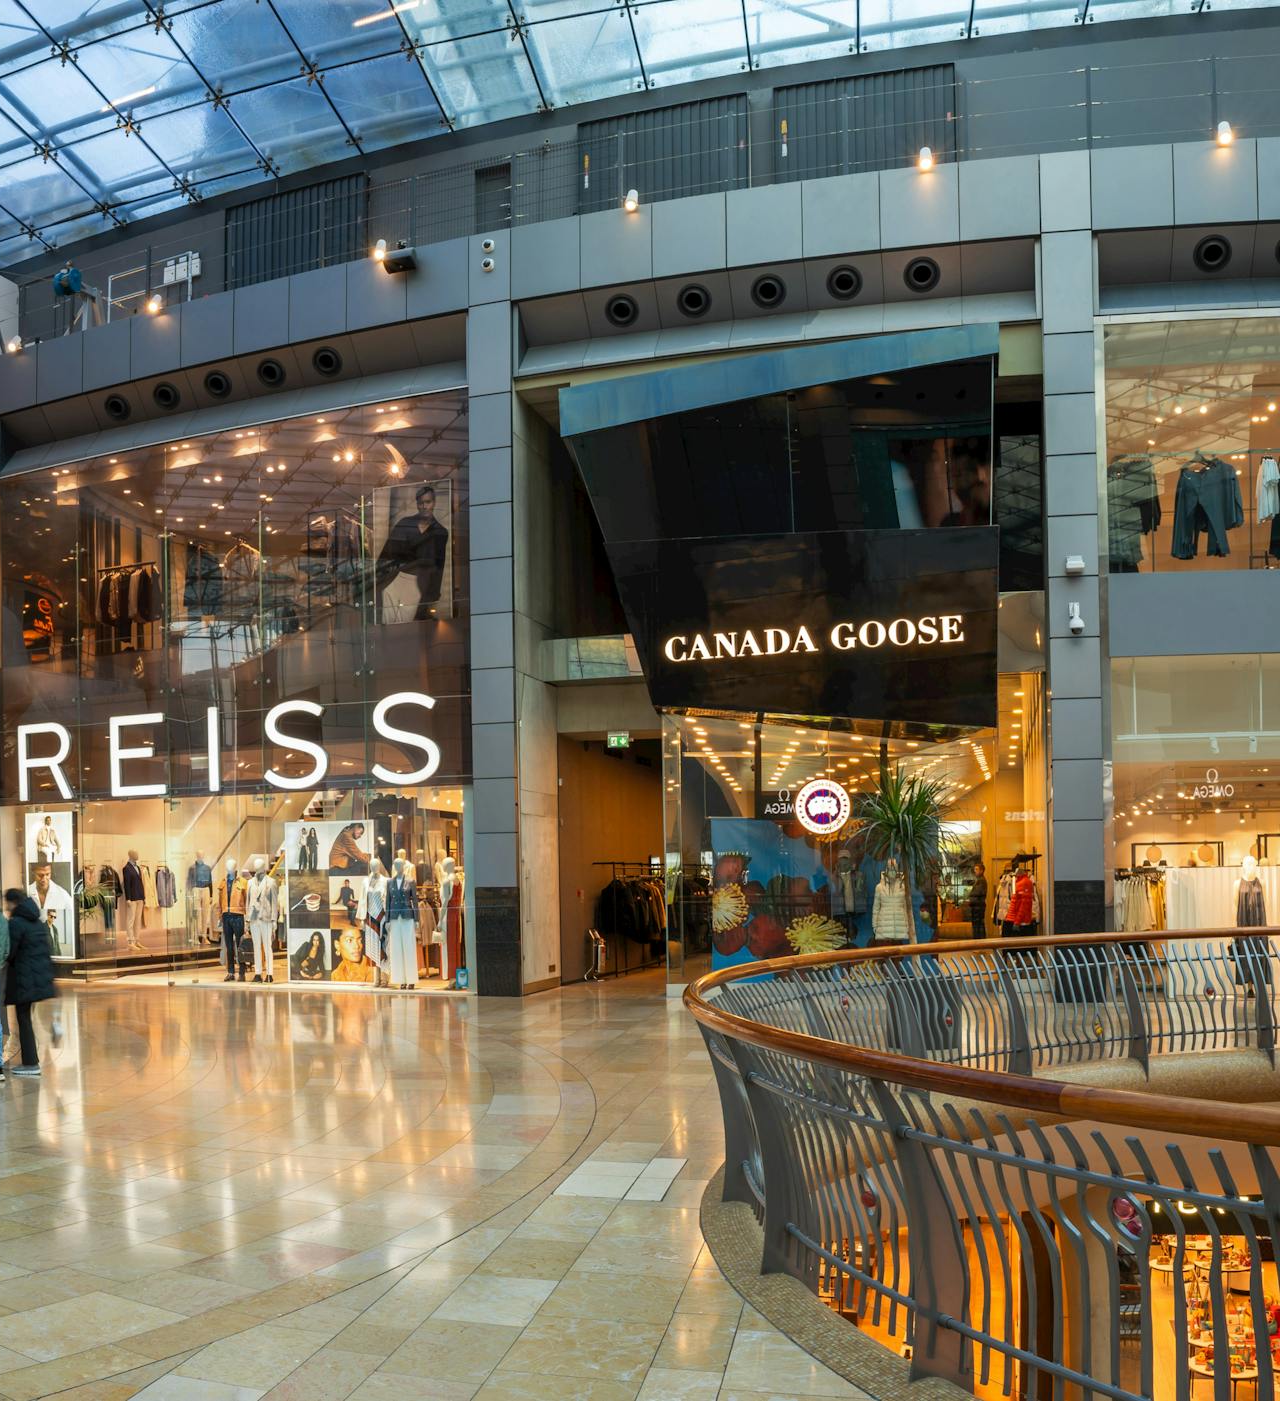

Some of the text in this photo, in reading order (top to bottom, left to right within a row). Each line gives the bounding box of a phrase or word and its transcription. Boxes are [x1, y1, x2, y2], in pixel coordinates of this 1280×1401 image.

[664, 615, 965, 662] CANADA GOOSE
[18, 691, 440, 801] REISS
